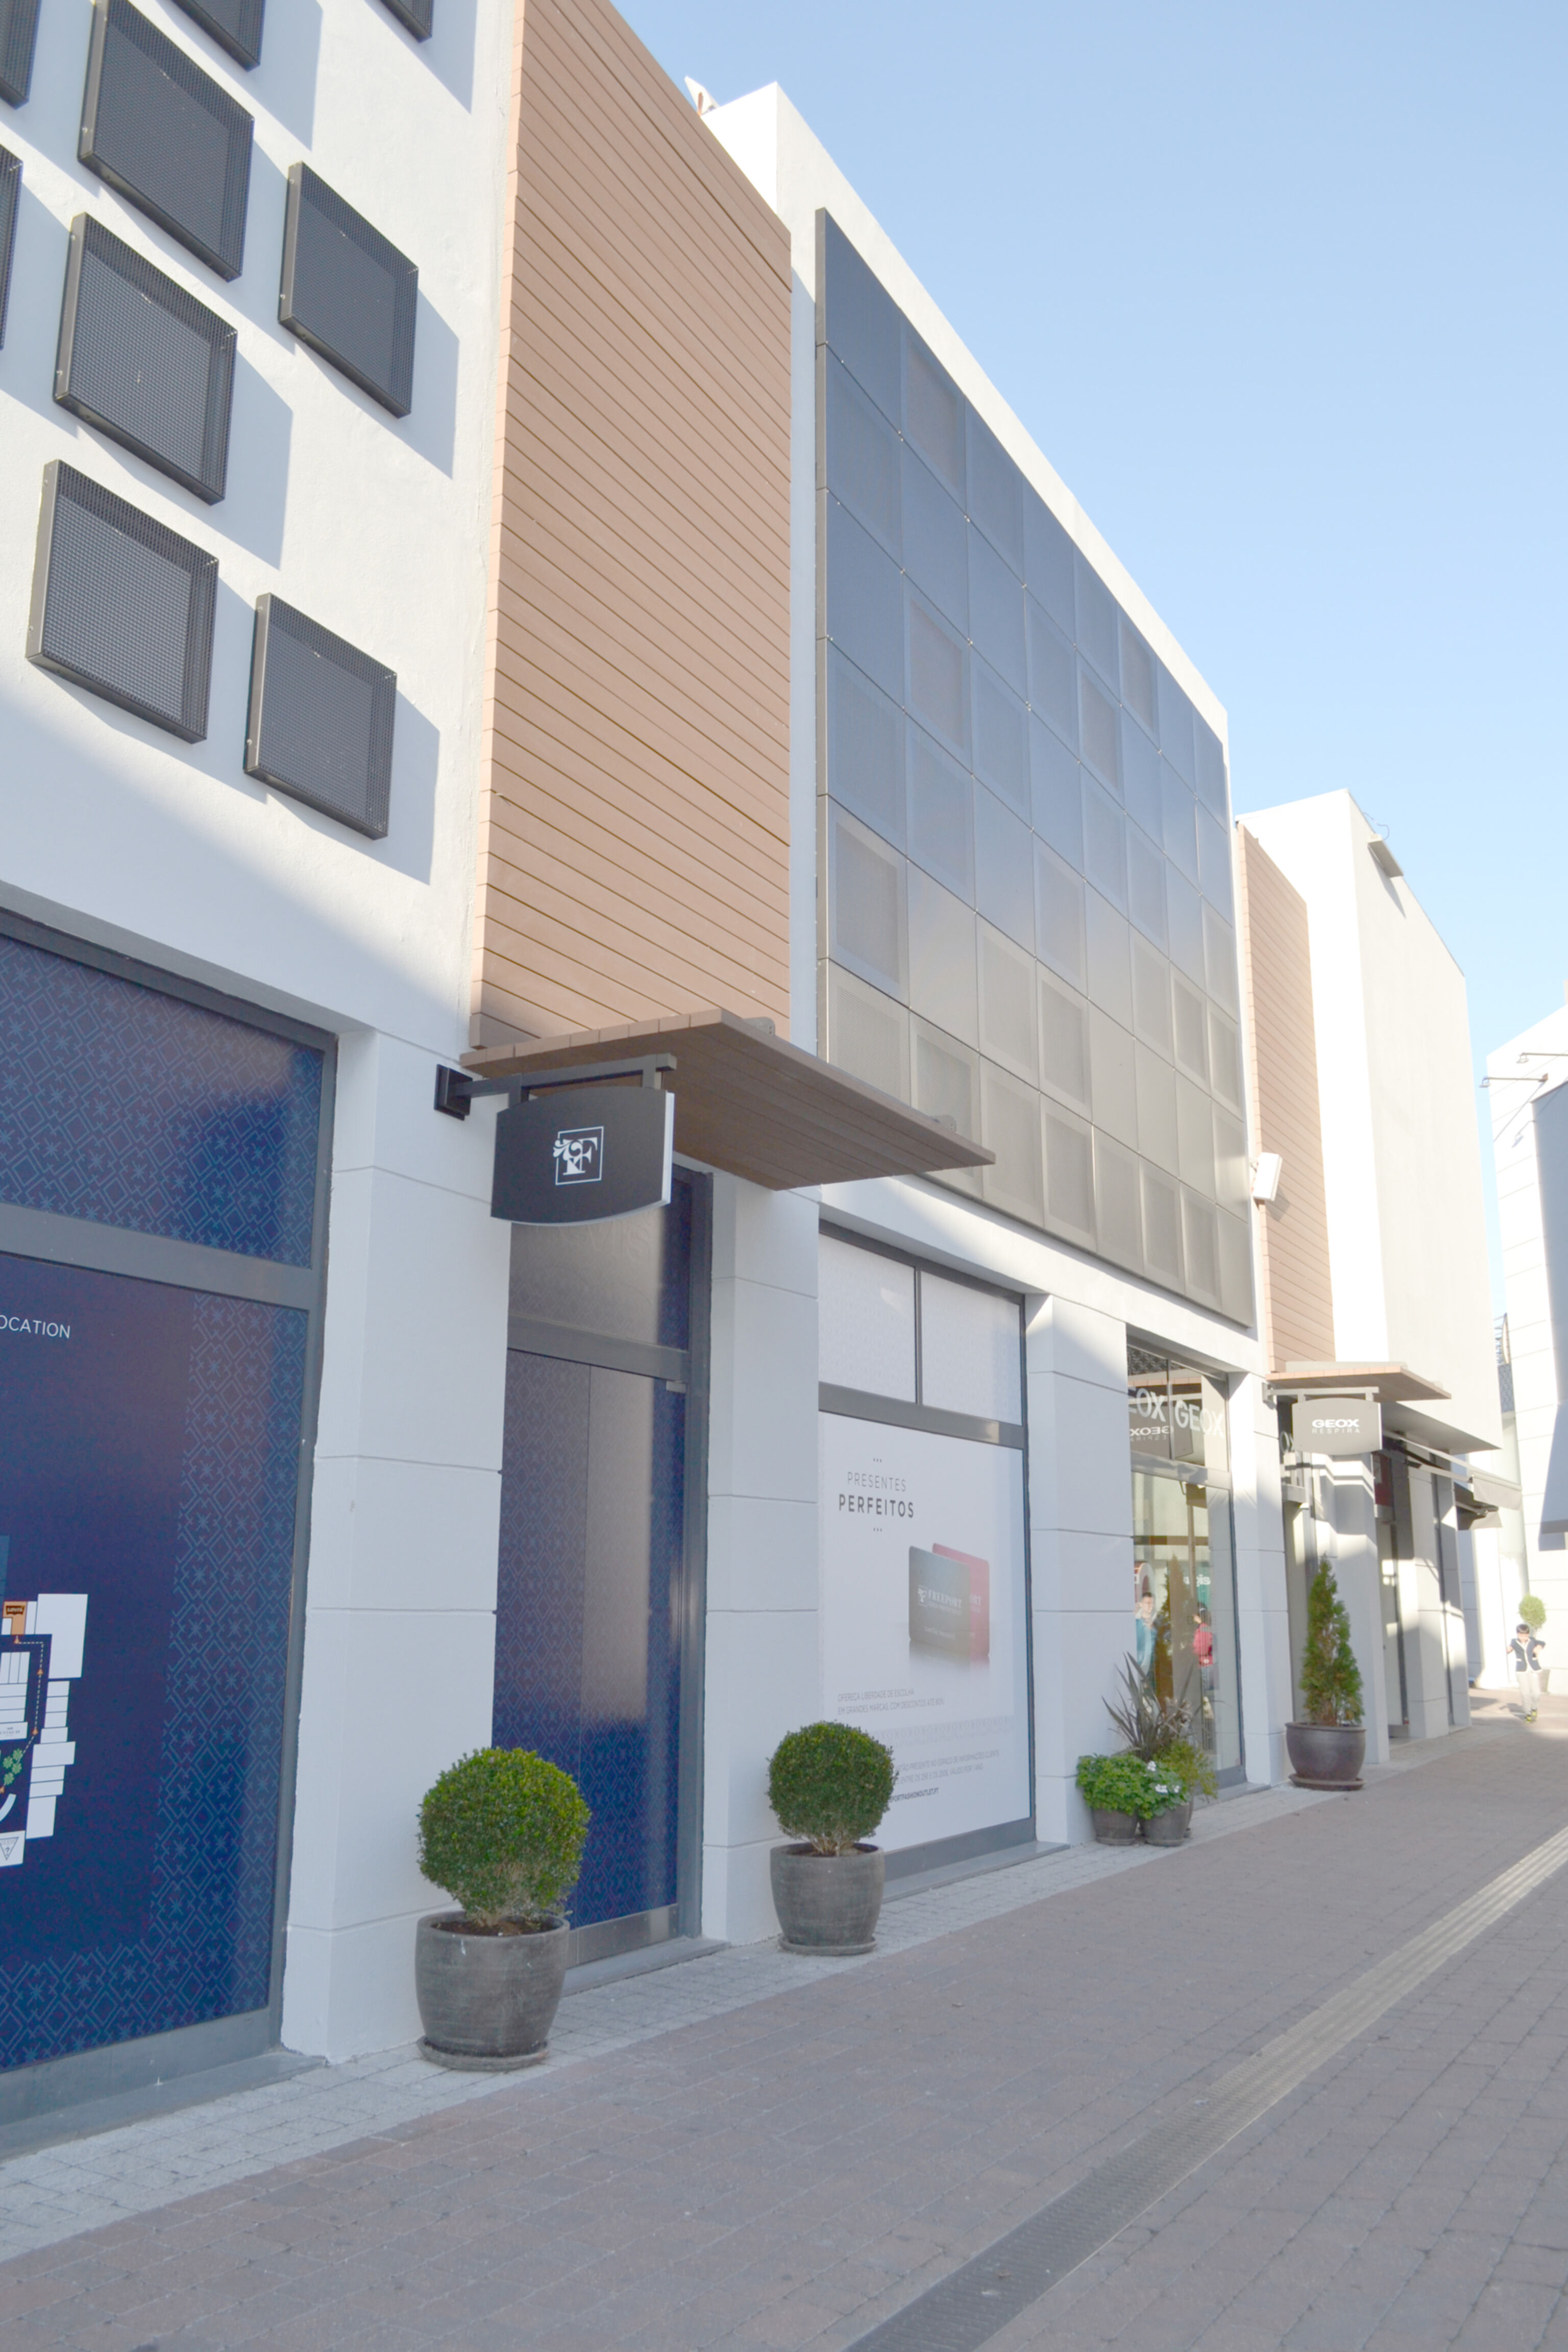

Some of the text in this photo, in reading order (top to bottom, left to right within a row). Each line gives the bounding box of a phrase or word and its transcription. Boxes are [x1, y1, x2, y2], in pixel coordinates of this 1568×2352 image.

[0, 1315, 70, 1339] OCATION
[1175, 1400, 1224, 1439] GEOX
[1312, 1419, 1360, 1428] GEOX
[847, 1472, 906, 1492] PRESENTES
[839, 1493, 914, 1518] PERFEITOS
[928, 1589, 962, 1608] FREEPORT
[887, 1689, 893, 1698] DE
[838, 1707, 845, 1715] EM
[846, 1705, 868, 1714] GRANDES
